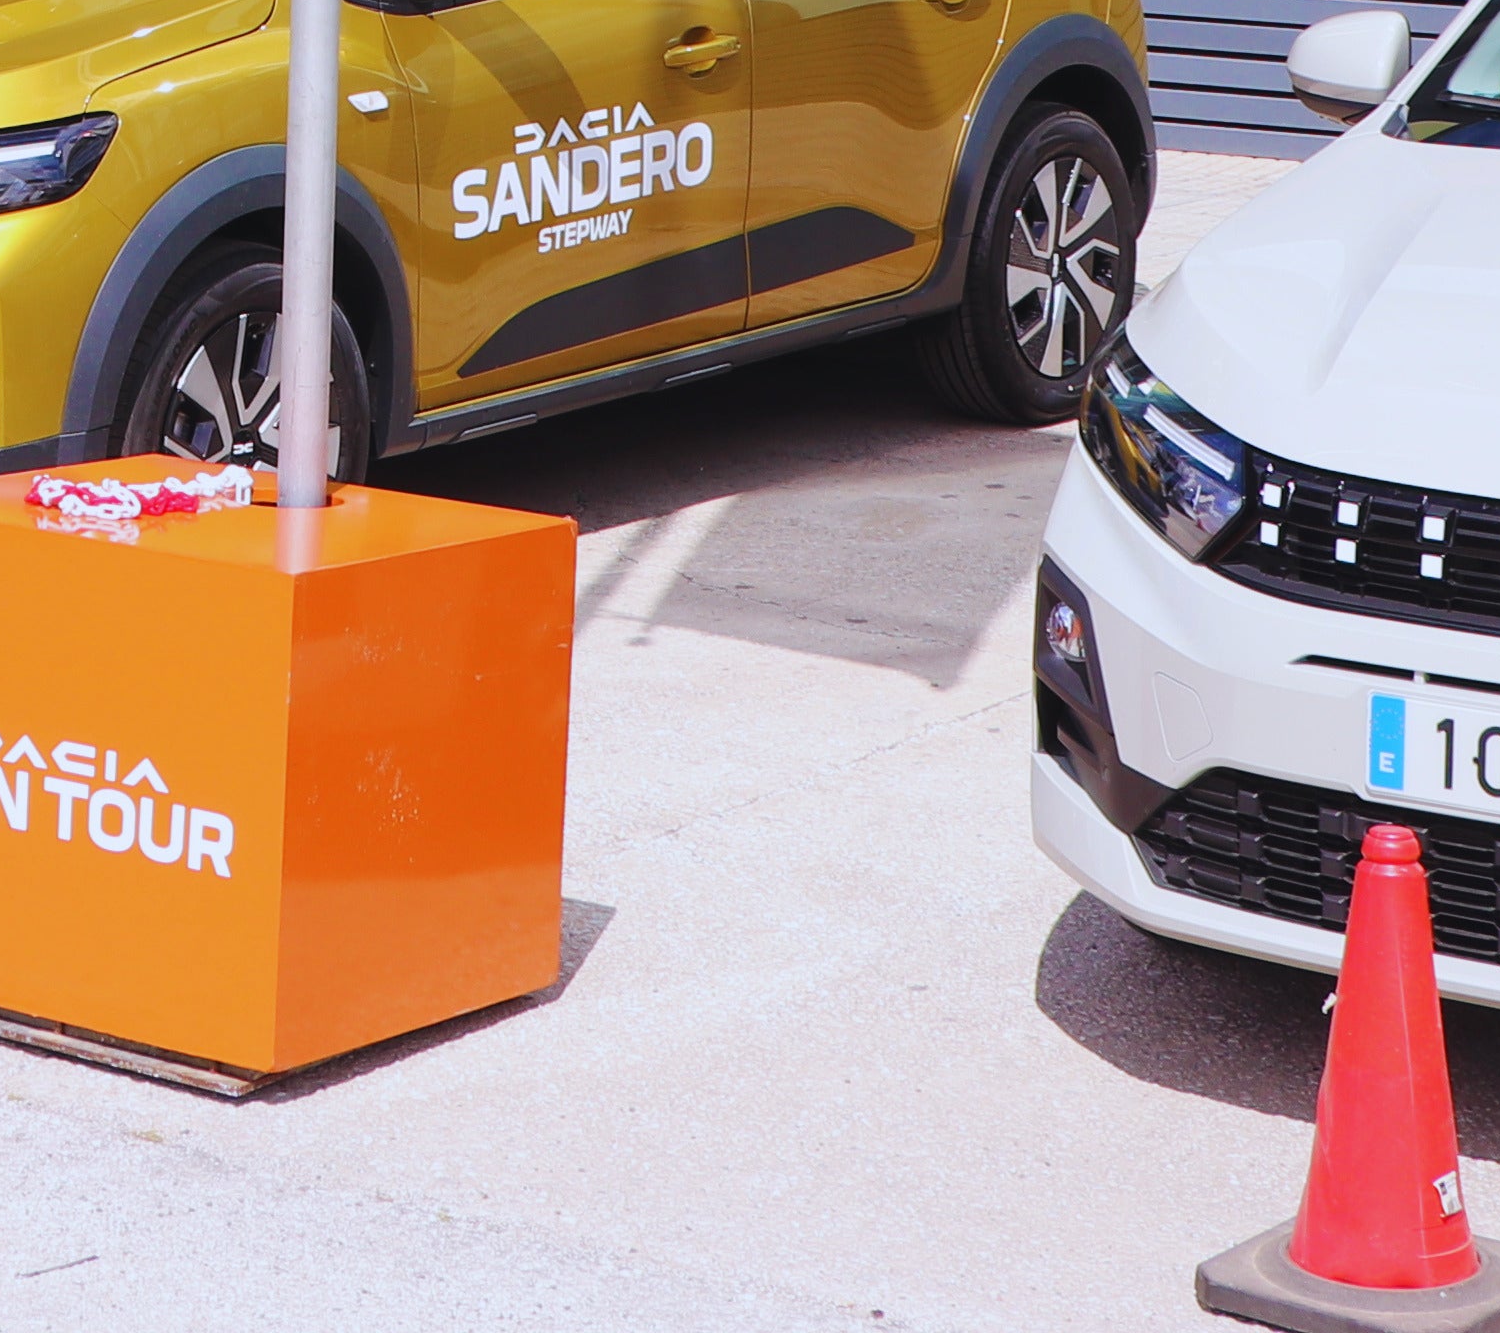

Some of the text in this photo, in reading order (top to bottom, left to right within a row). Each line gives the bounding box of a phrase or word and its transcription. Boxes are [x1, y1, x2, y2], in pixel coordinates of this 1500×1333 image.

[513, 101, 656, 155] DACIA
[452, 121, 713, 240] SANDERO
[537, 208, 633, 254] STEPWAY
[1379, 751, 1396, 774] E
[43, 775, 235, 879] TOUR
